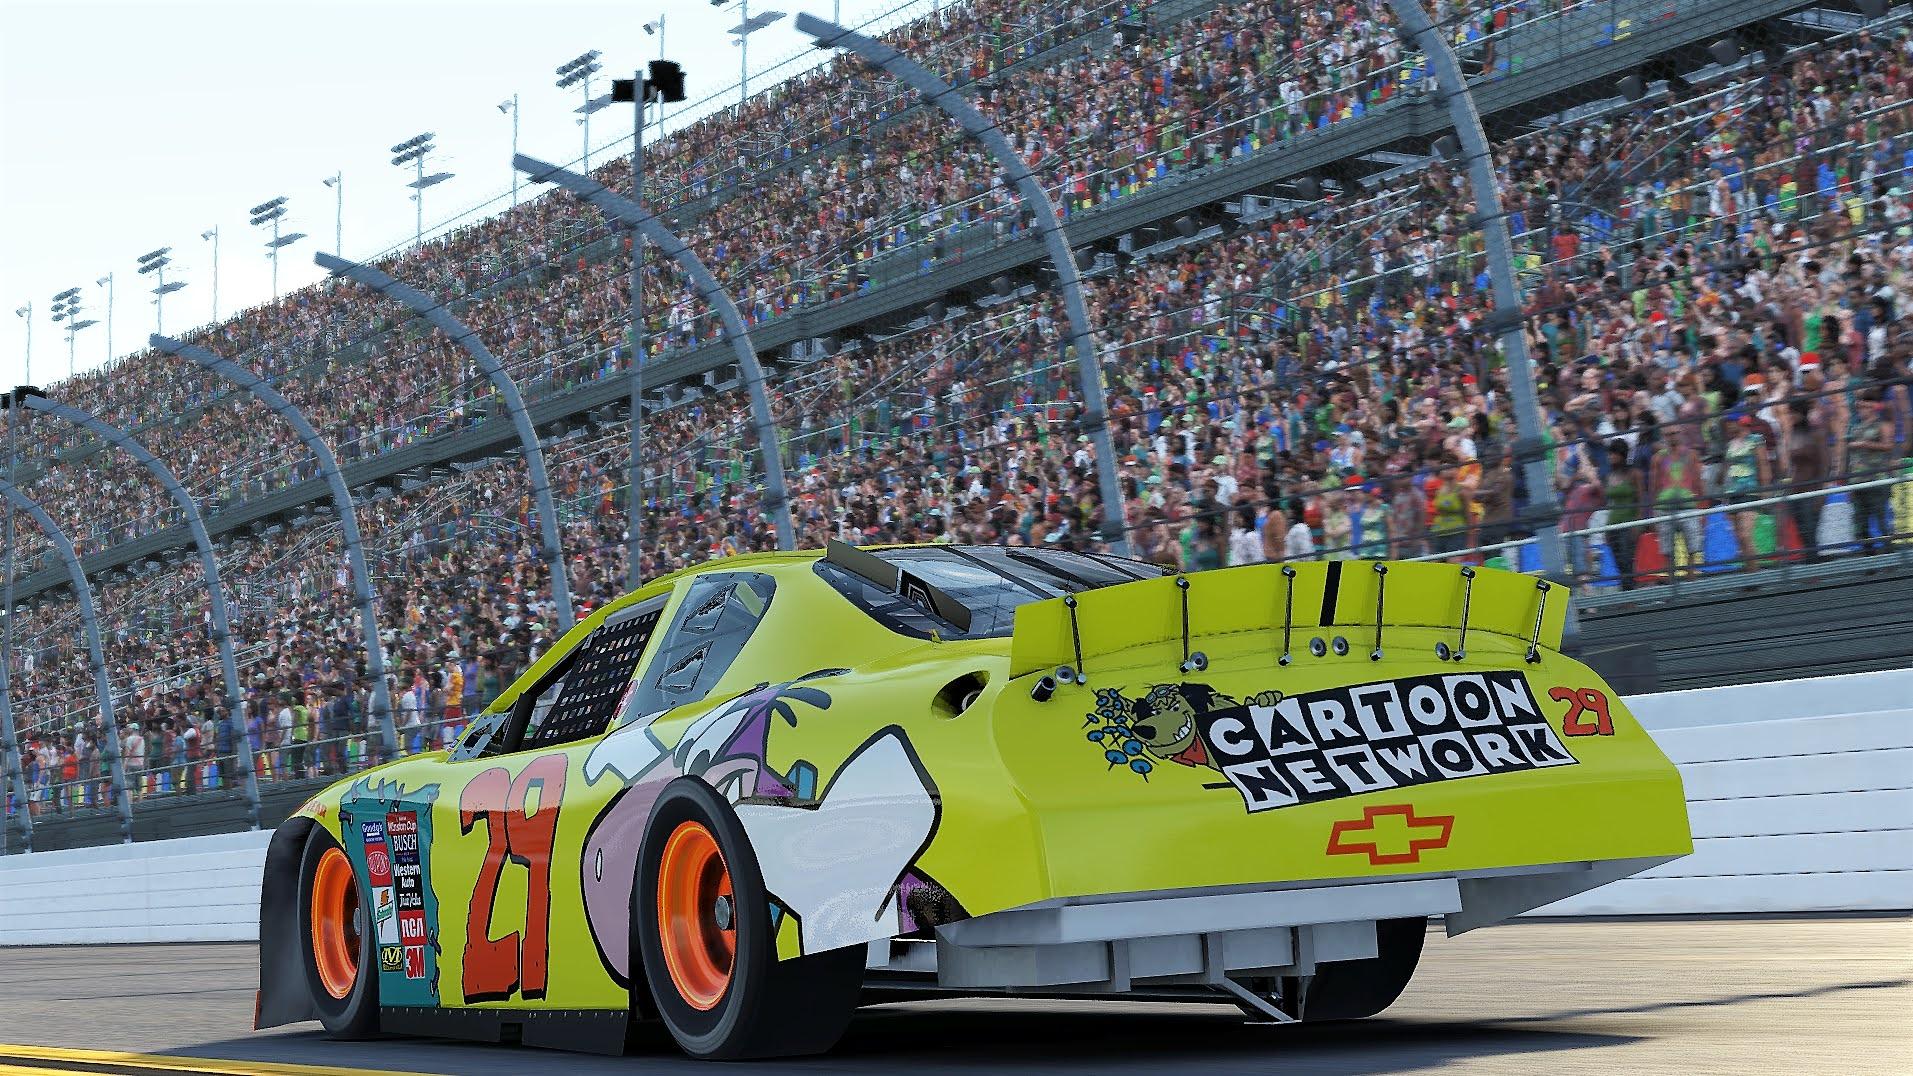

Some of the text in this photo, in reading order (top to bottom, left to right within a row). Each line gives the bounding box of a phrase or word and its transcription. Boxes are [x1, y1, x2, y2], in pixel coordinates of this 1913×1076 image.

[1209, 678, 1540, 756] CARTOON
[1548, 686, 1615, 736] 29
[1231, 727, 1570, 802] NETWORK
[393, 833, 417, 852] BUSCH
[394, 863, 421, 877] Western
[401, 876, 415, 889] Auto
[459, 753, 569, 1005] 29
[401, 917, 424, 938] RCA
[405, 946, 425, 979] 3M
